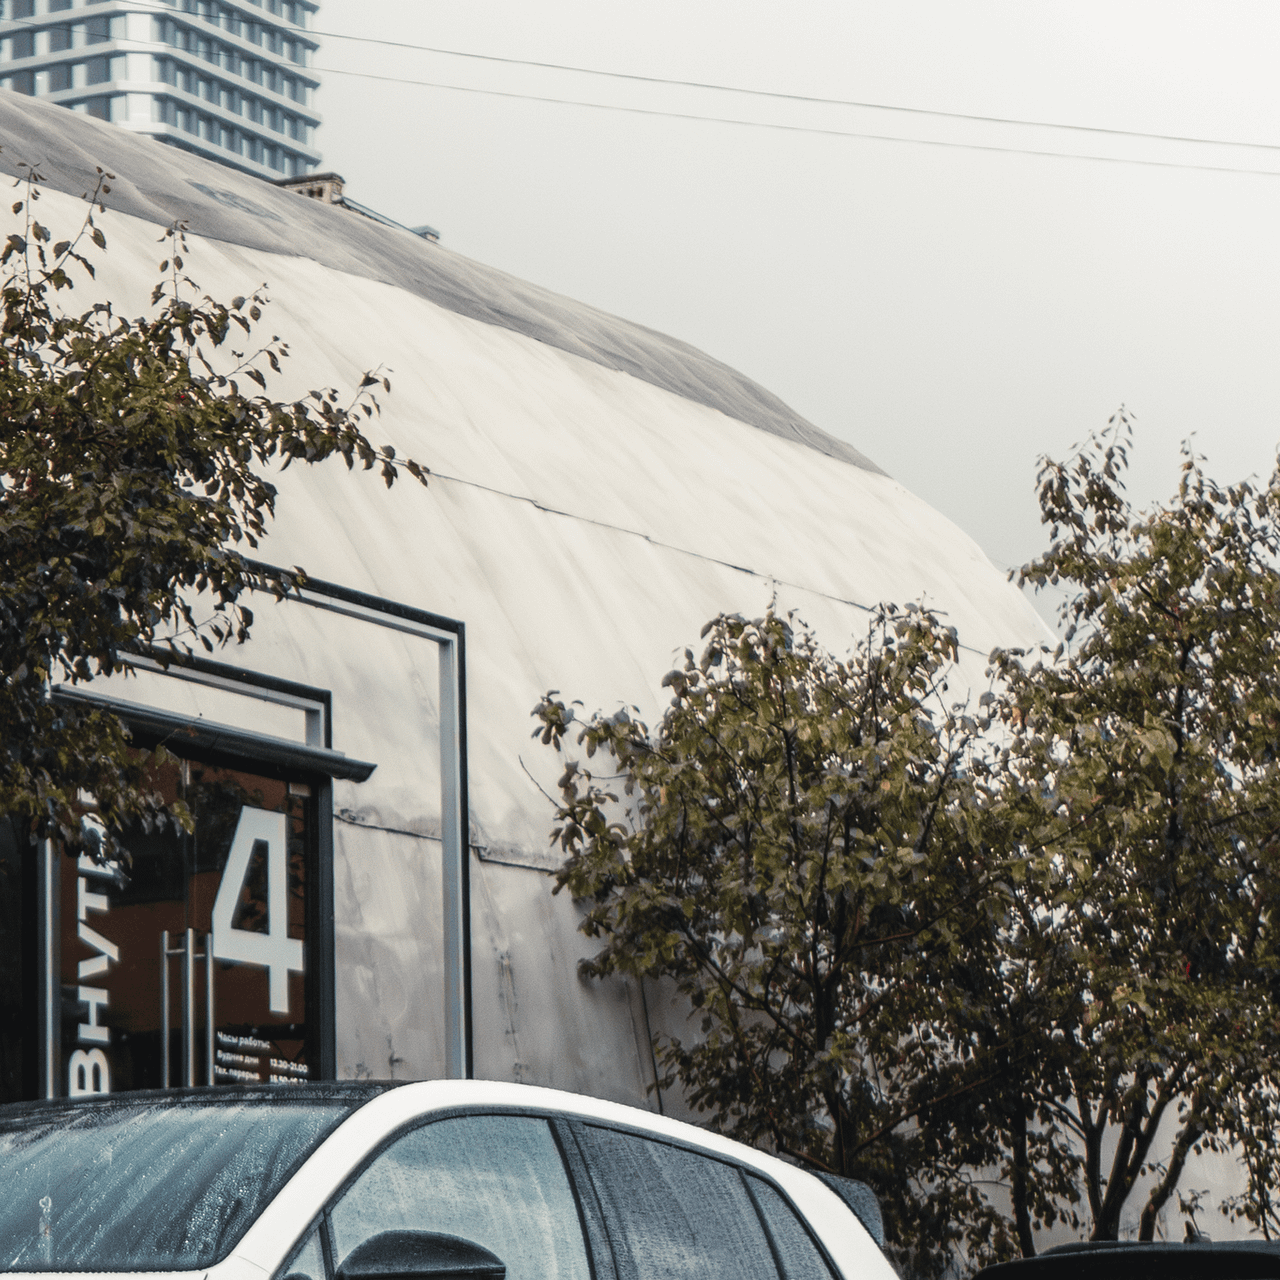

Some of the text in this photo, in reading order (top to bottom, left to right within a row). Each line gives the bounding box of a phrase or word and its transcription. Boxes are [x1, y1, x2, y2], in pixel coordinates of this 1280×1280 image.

[211, 805, 304, 1014] 4
[217, 1031, 270, 1049] Часы работы:
[217, 1049, 244, 1062] Будние
[244, 1055, 260, 1064] дни
[214, 1065, 228, 1075] Тех.
[228, 1068, 260, 1080] перерыв
